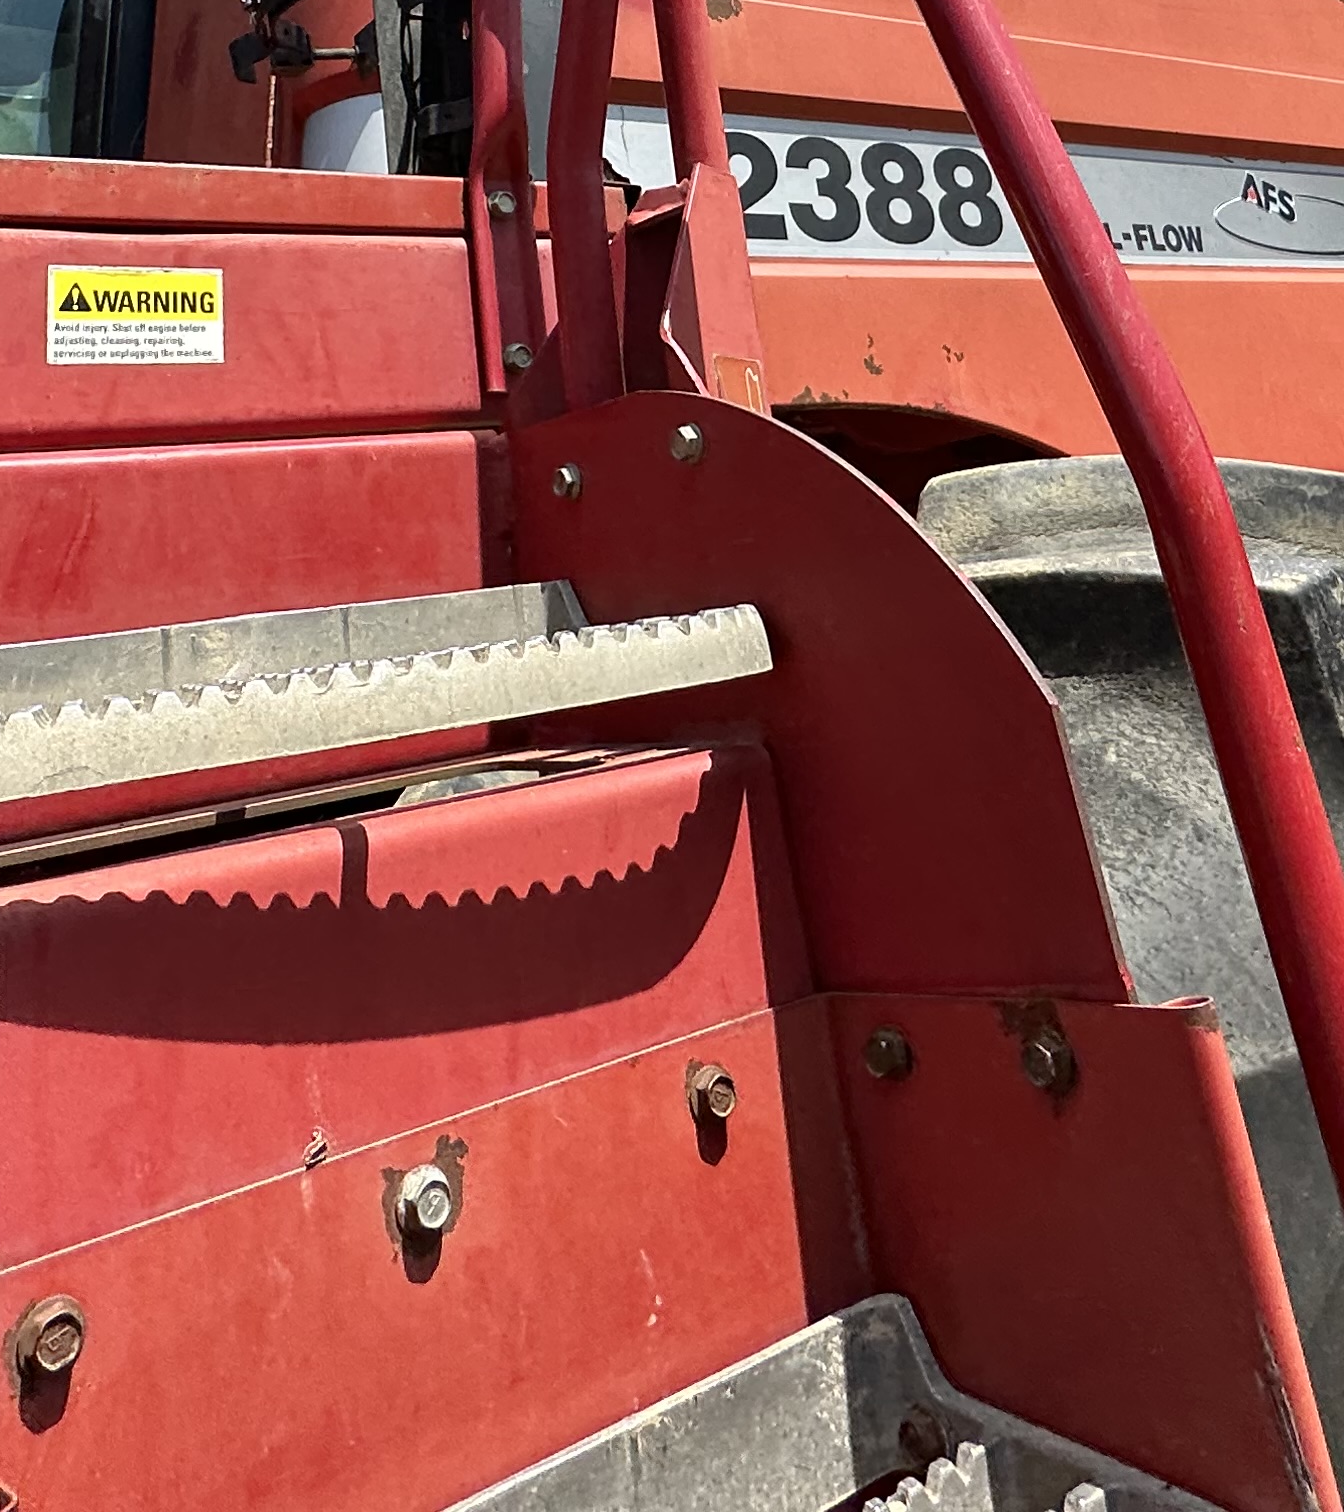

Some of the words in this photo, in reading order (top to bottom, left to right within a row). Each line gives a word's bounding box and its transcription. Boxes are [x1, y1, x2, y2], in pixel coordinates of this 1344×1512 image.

[724, 131, 1004, 247] 2388
[1241, 171, 1298, 223] AFS
[93, 290, 215, 314] WARNING
[54, 322, 80, 333] Avoid
[148, 324, 177, 335] engine
[179, 323, 206, 333] before
[54, 349, 96, 360] servicing
[98, 350, 107, 358] or
[110, 349, 159, 360] unplugging
[161, 348, 175, 358] the
